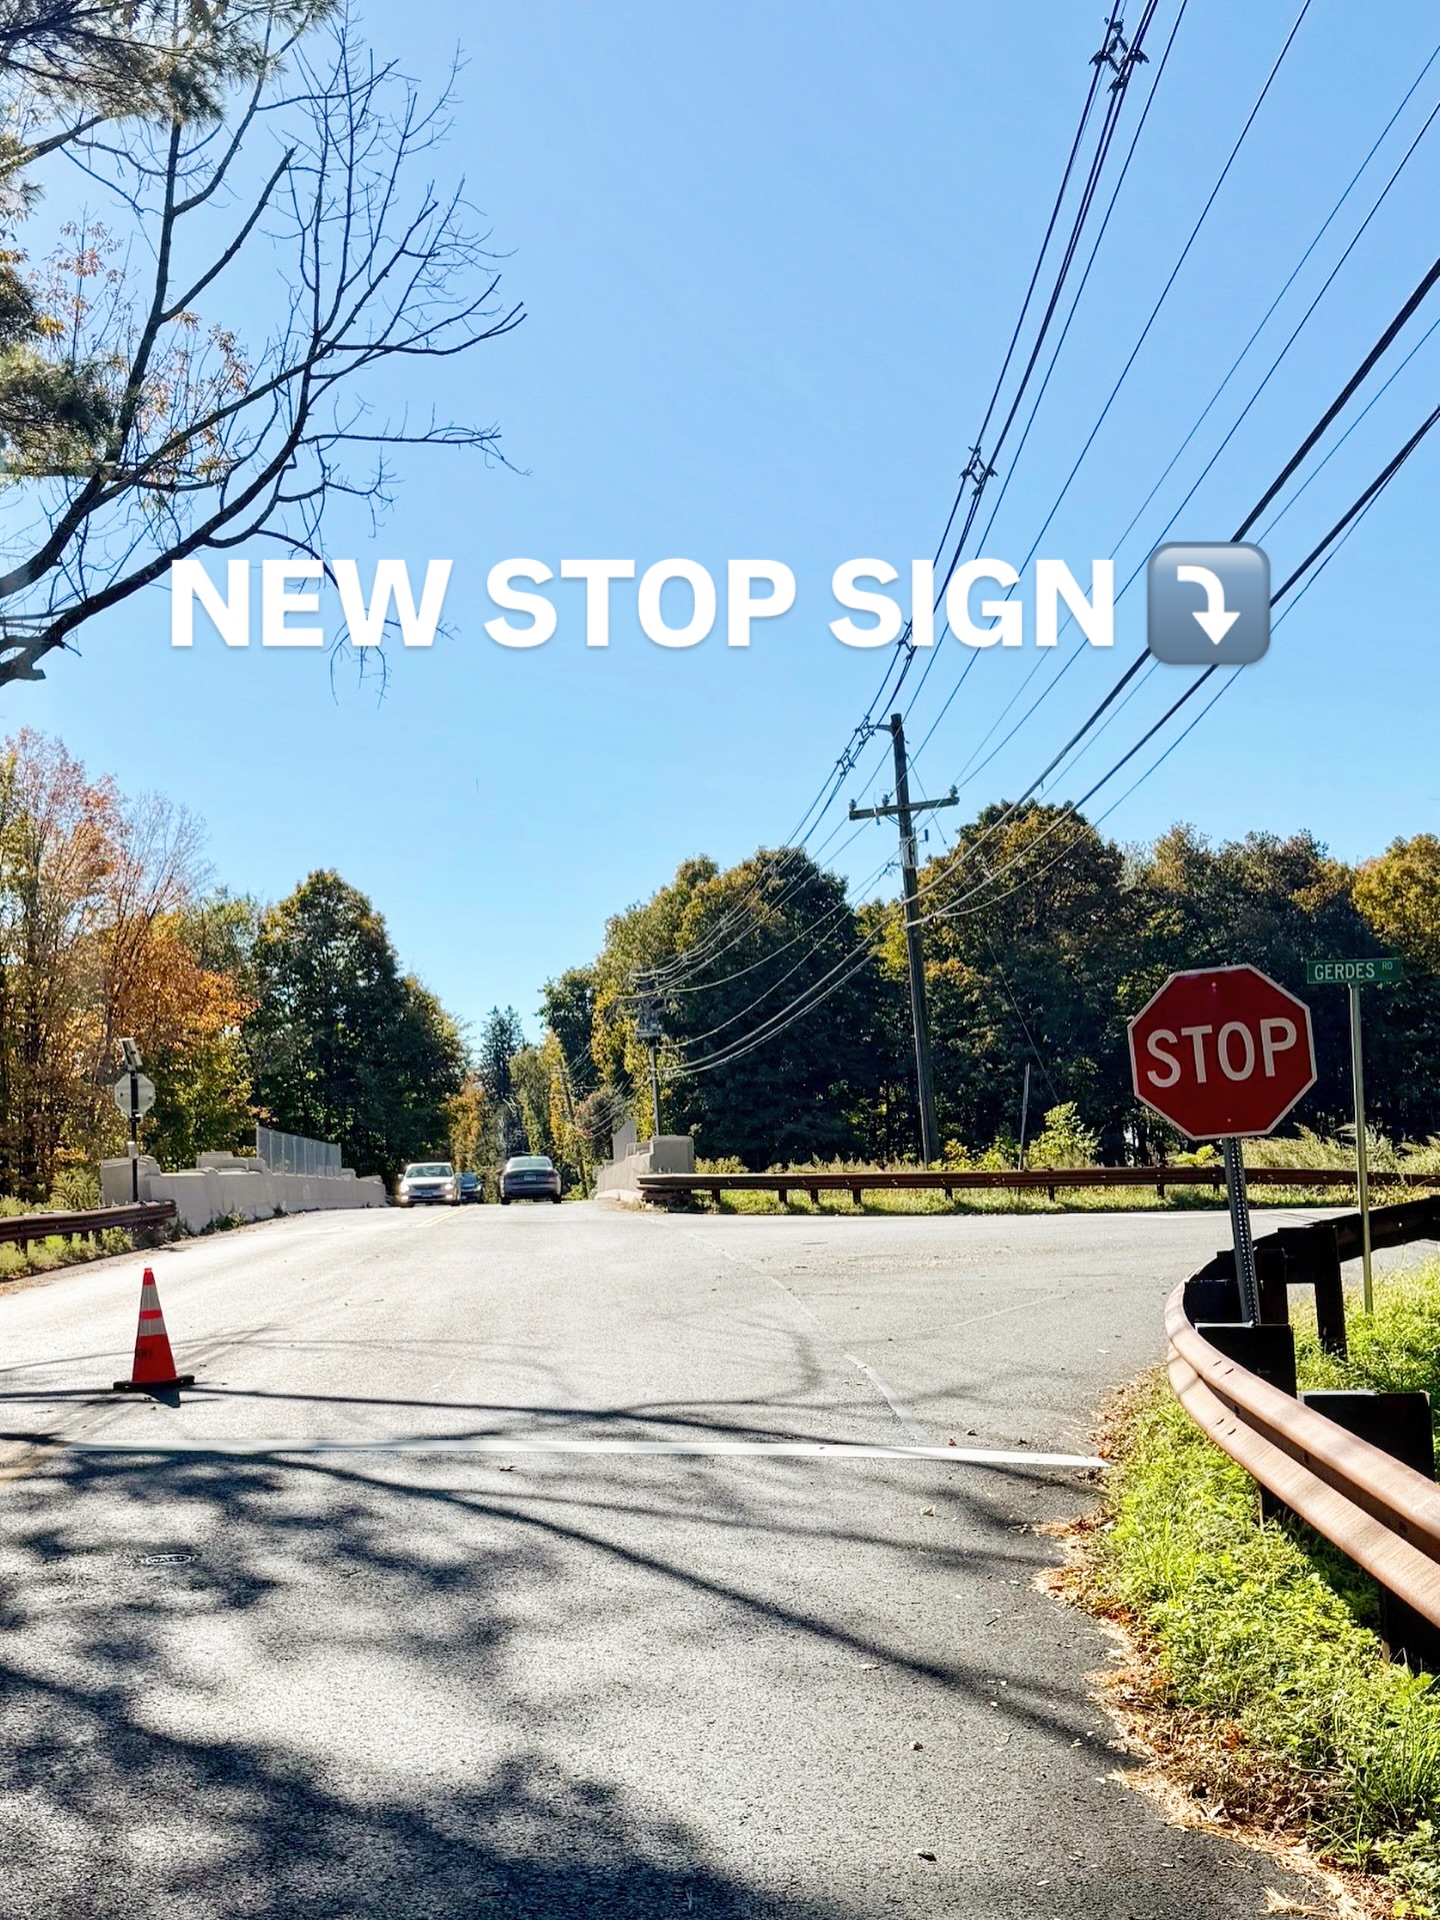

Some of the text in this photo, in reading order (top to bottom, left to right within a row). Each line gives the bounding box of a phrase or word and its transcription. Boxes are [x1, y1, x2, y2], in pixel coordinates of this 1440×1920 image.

[1314, 961, 1393, 980] GERDES RD
[1146, 1017, 1297, 1088] STOP
